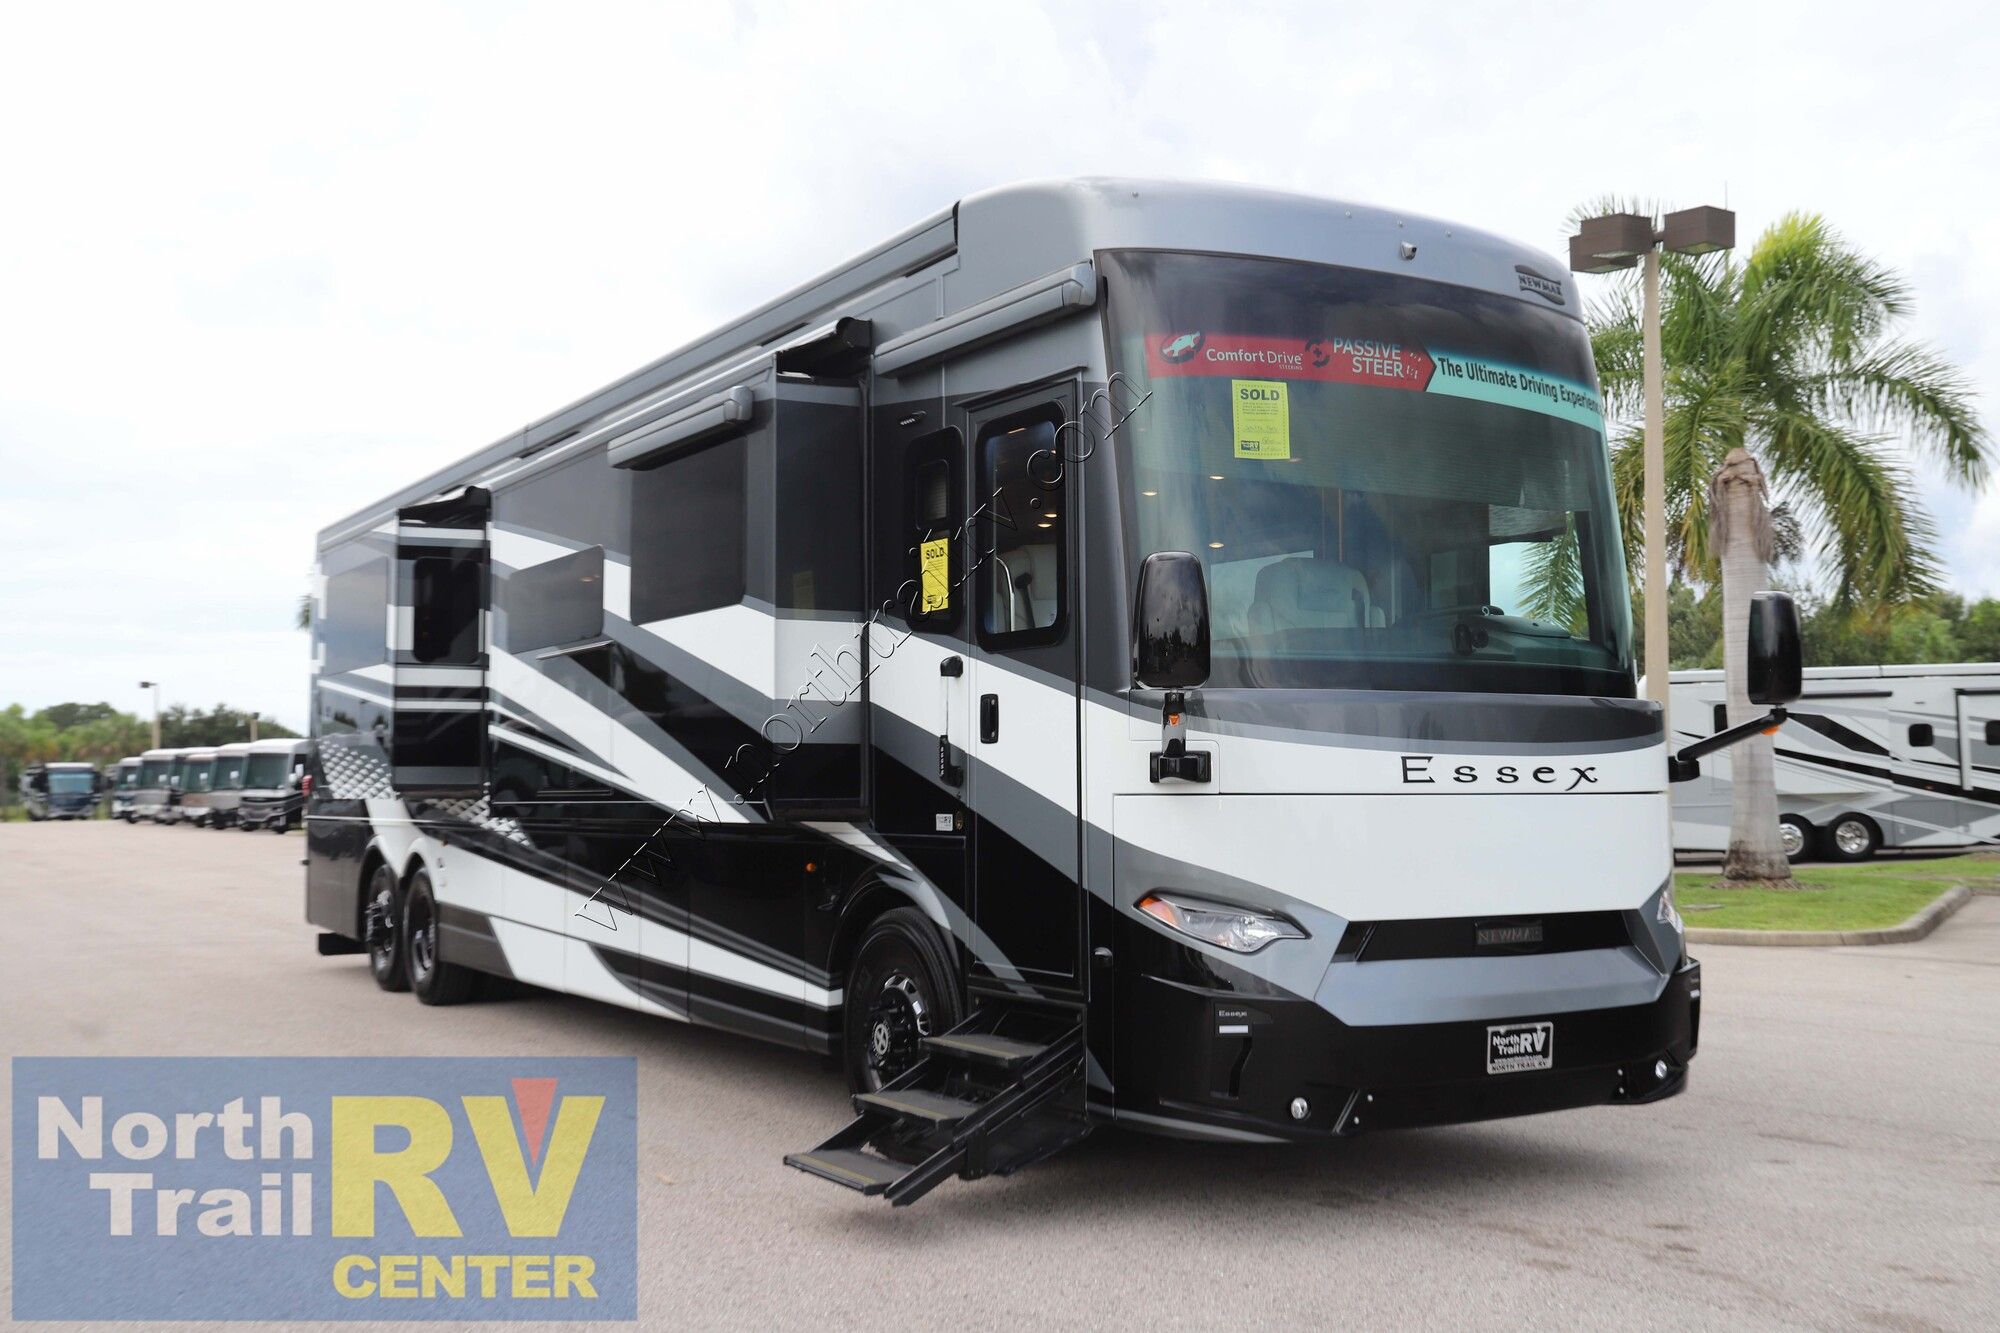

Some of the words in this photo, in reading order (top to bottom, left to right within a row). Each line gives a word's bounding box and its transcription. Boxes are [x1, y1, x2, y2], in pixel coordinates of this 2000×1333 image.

[1206, 348, 1265, 363] Comfort
[1267, 350, 1302, 365] Drive
[1333, 337, 1401, 361] PASSIVE
[1352, 355, 1404, 378] STEER
[1438, 357, 1463, 378] The
[1465, 362, 1518, 389] Ultimate
[1519, 373, 1558, 403] Driving
[1240, 388, 1280, 401] SOLD
[925, 547, 945, 560] SOLD
[1400, 756, 1599, 792] Essex
[1493, 1034, 1520, 1046] North
[1520, 1032, 1546, 1053] RV
[1498, 1045, 1520, 1055] Trail
